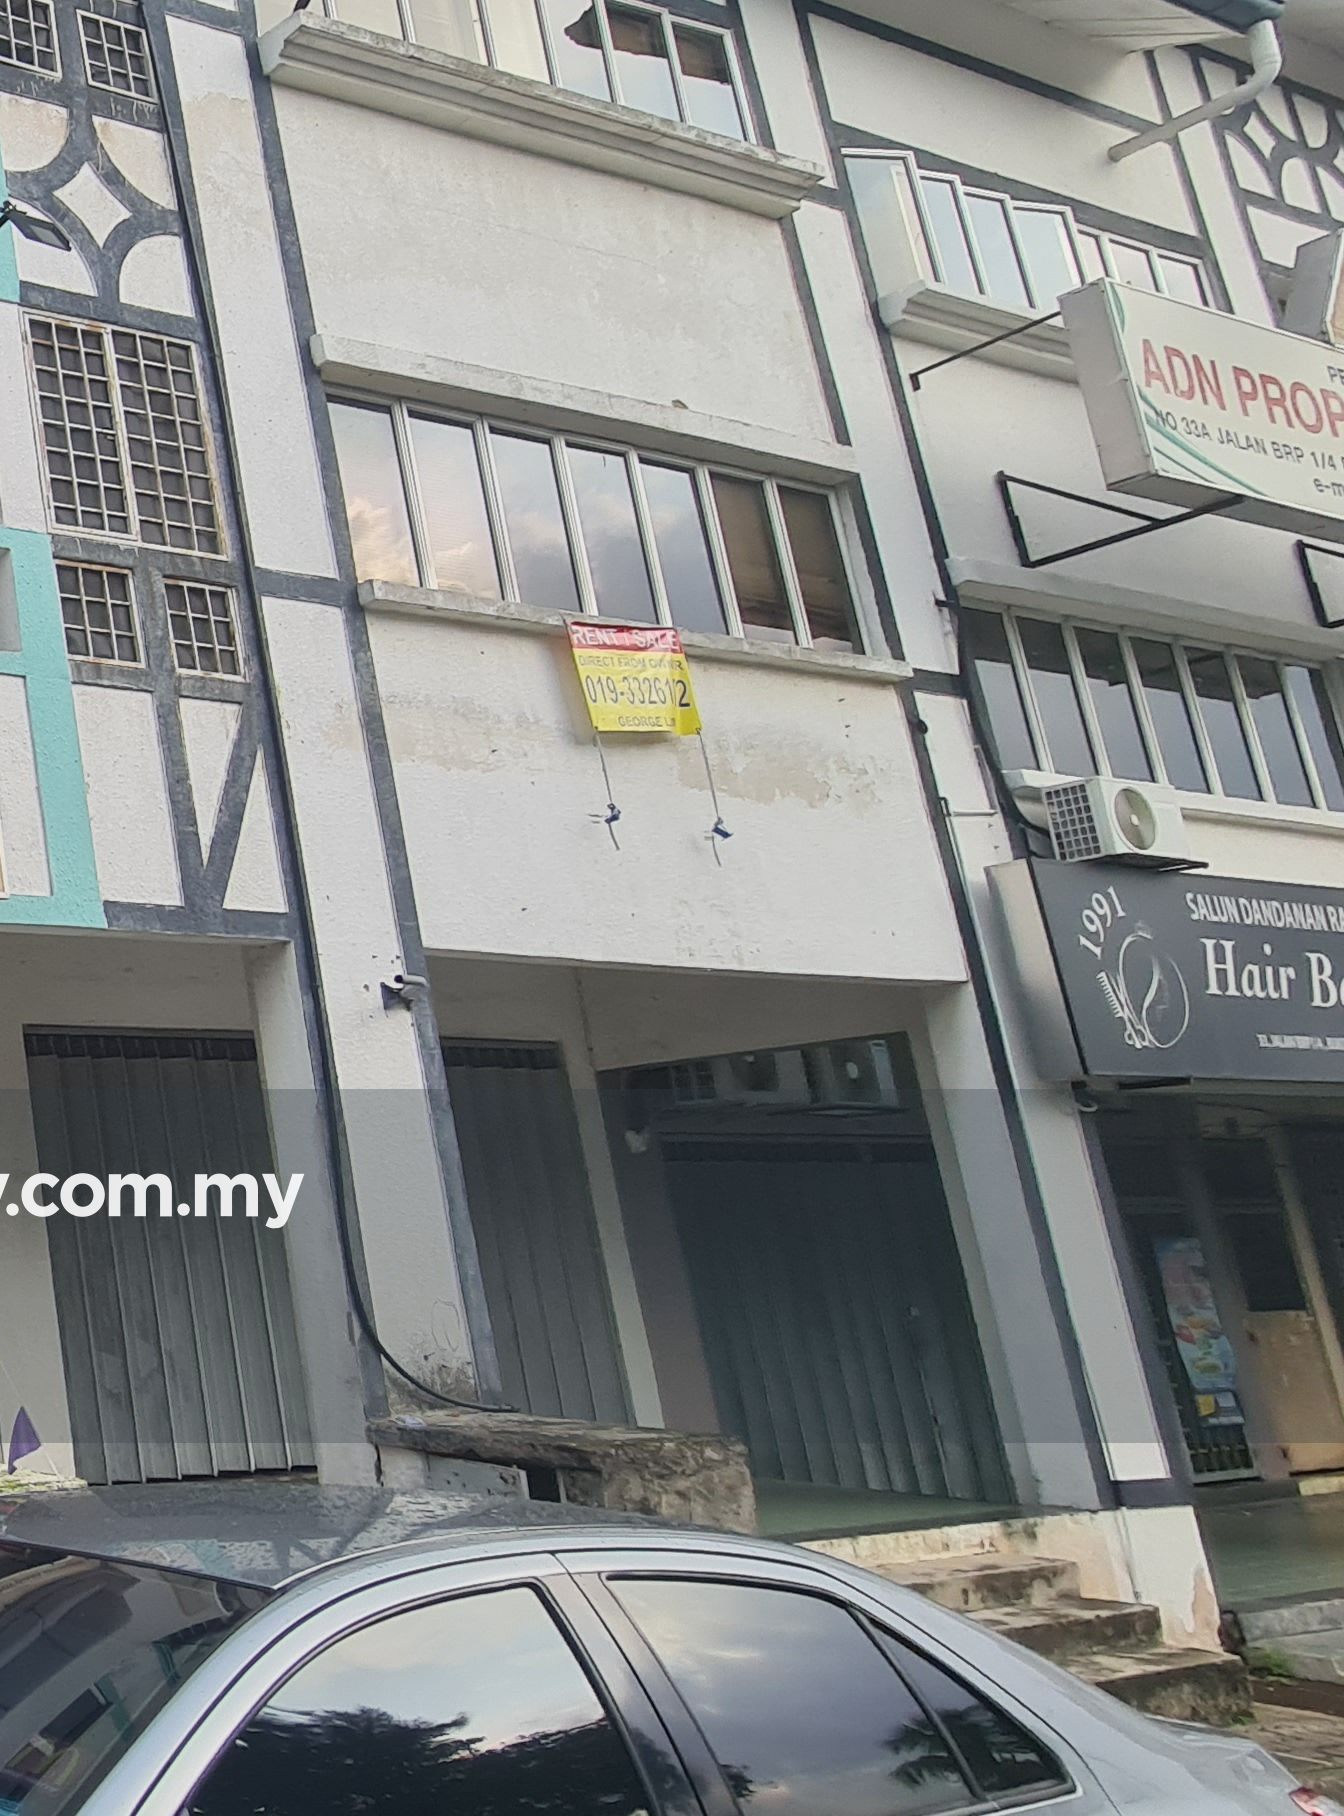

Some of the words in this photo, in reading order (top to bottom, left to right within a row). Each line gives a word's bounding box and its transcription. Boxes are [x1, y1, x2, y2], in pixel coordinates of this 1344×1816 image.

[1142, 338, 1227, 411] ADN
[1181, 416, 1212, 441] 33A
[1217, 427, 1268, 456] JALAN
[1271, 441, 1304, 465] BRP
[1309, 451, 1337, 471] 1/4
[571, 626, 618, 647] RENT
[635, 630, 682, 651] SALE
[618, 716, 663, 728] GEORGE
[1186, 892, 1242, 923] SALUN
[1241, 897, 1328, 932] DANDANAN
[1200, 937, 1296, 999] Hair
[1305, 951, 1344, 1008] B
